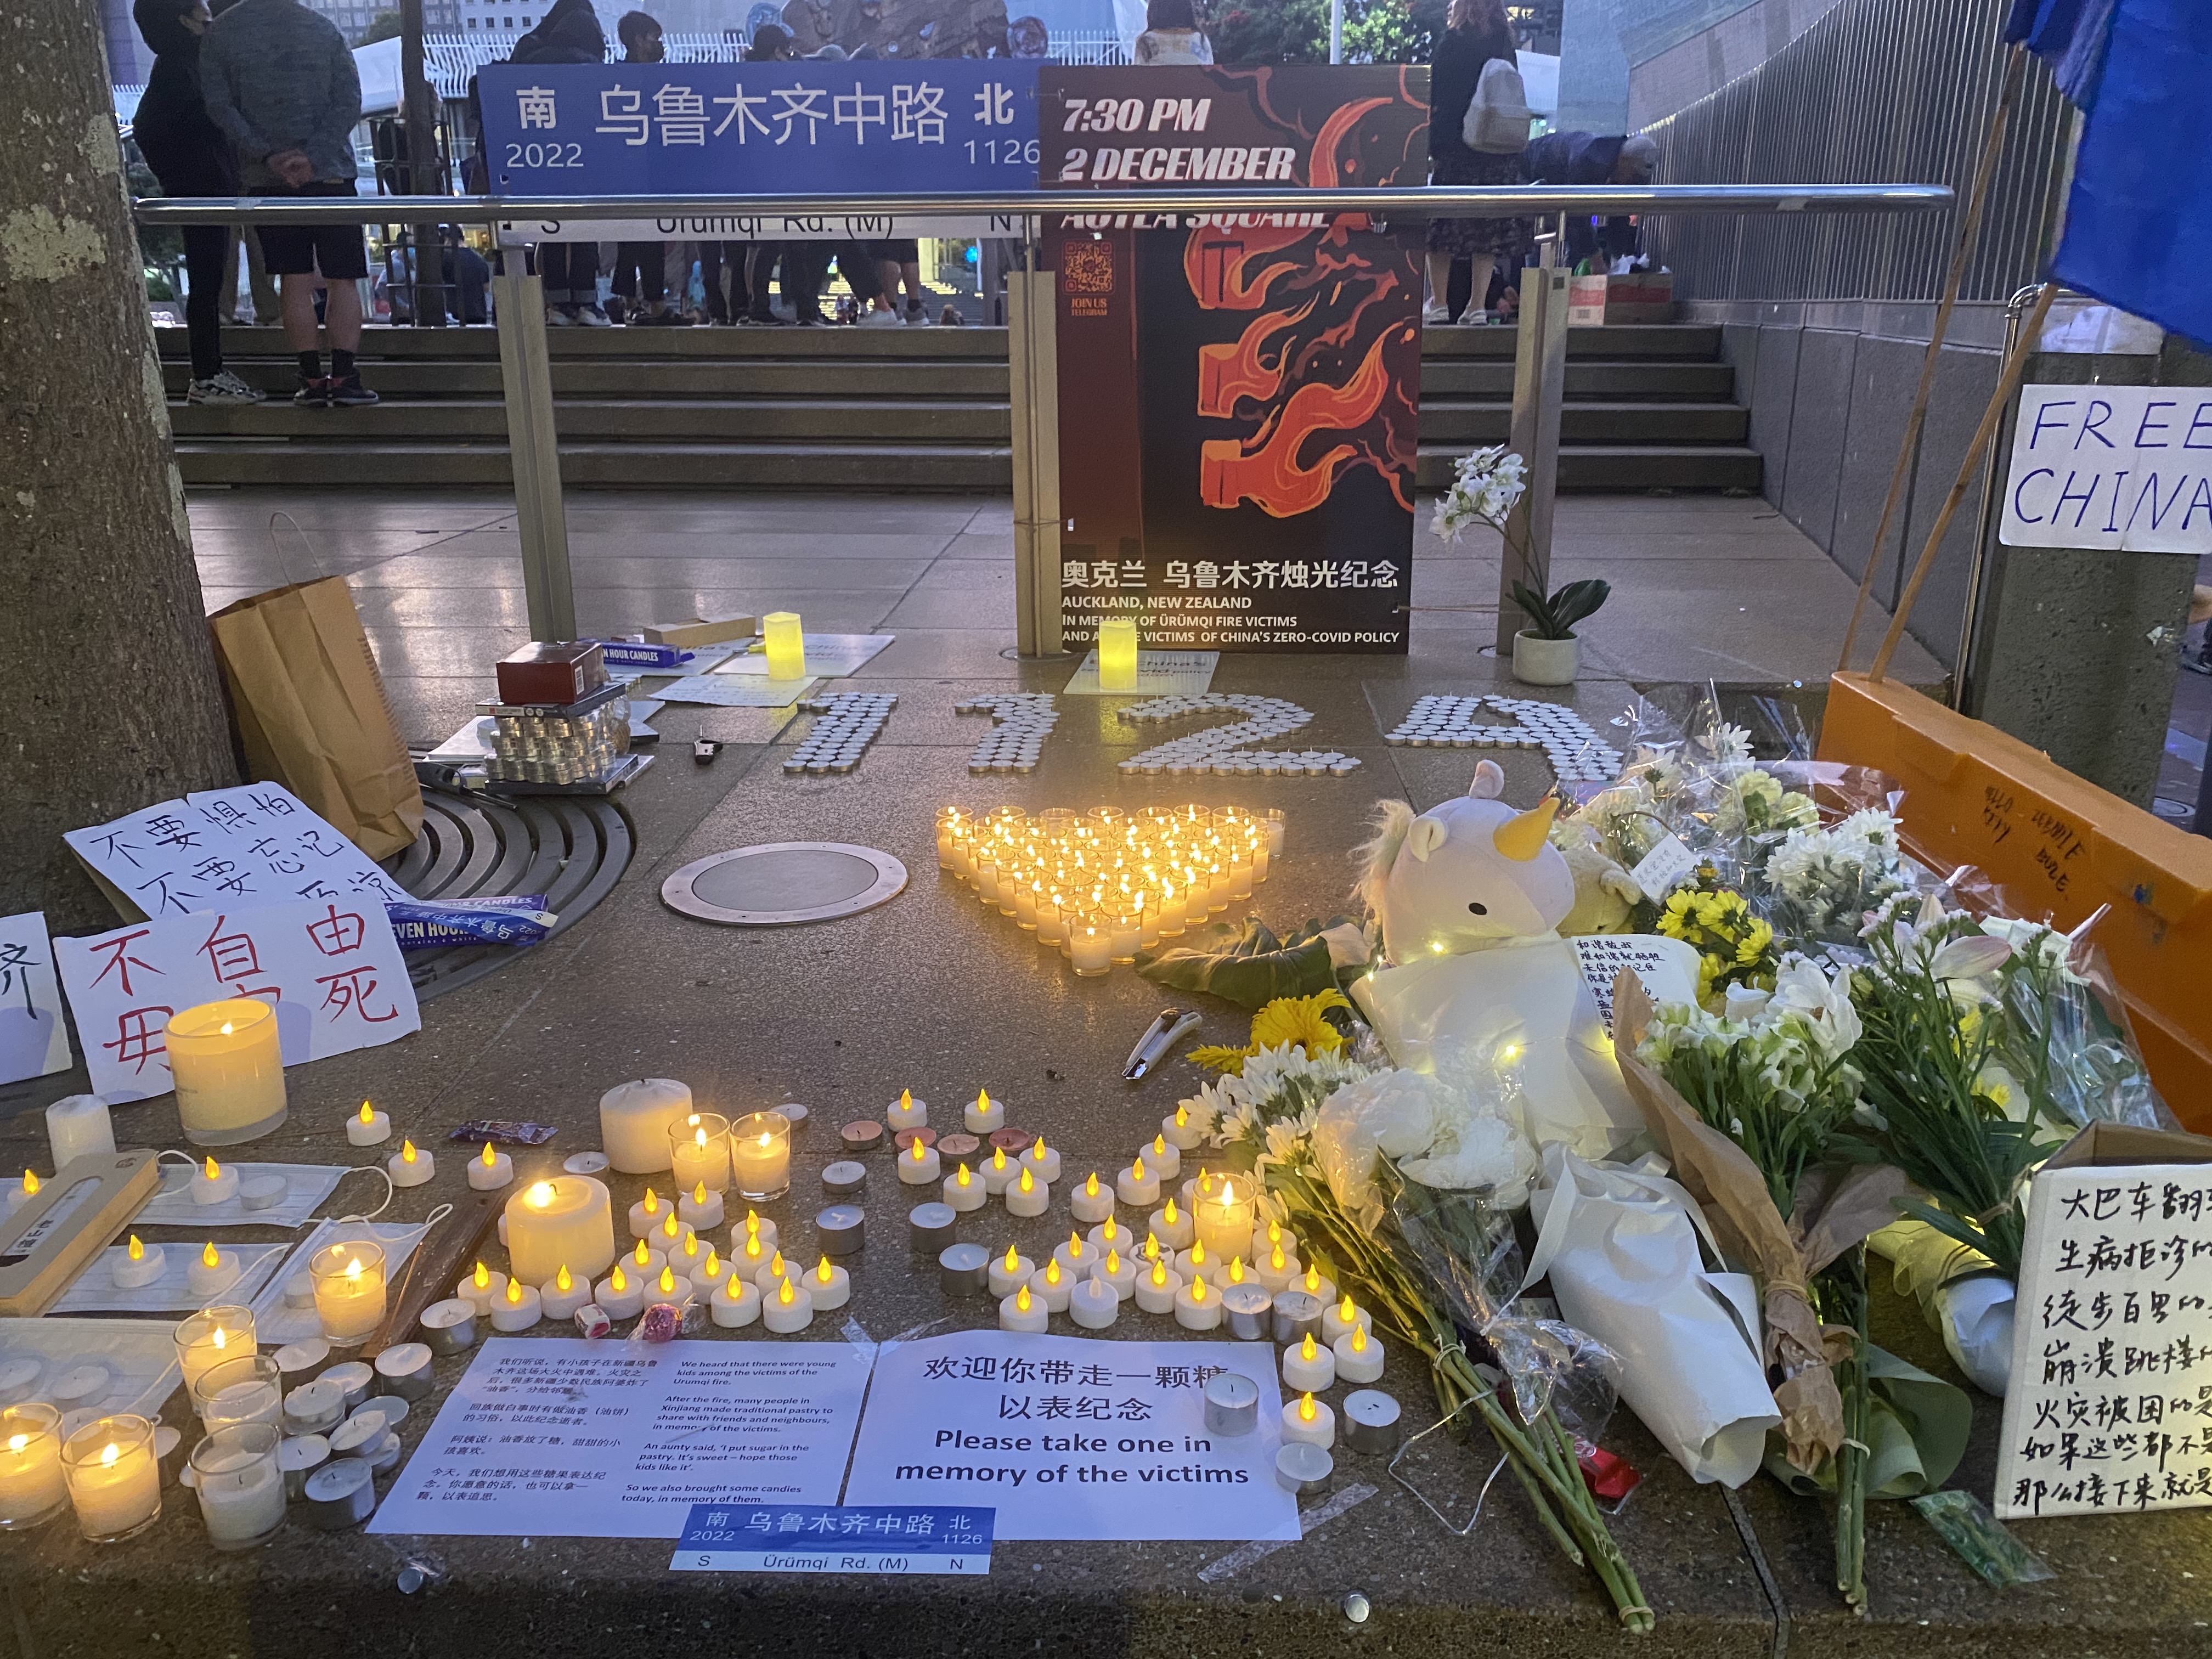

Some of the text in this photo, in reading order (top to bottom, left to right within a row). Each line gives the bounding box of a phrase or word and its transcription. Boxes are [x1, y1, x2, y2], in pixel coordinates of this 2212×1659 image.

[516, 82, 1013, 146] 南 乌鲁木齐中路 北
[1062, 99, 1211, 132] 7:30 PM
[506, 139, 1039, 167] 2022 1126
[1062, 147, 1295, 180] 2 DECEMBER
[2030, 401, 2212, 449] FREE
[2015, 468, 2212, 532] CHINA
[1062, 561, 1398, 589] 奥克兰 乌鲁木齐烛光纪念
[1062, 597, 1251, 610] AUCKLAND, NEW ZEALAND
[1062, 614, 1076, 626] IN
[1139, 616, 1156, 627] OF
[1216, 617, 1242, 626] FIRE
[1246, 617, 1296, 626] VICTIMS
[1062, 631, 1089, 641] AND
[1144, 632, 1194, 642] VICTIMS
[1201, 633, 1218, 642] OF
[1220, 631, 1271, 642] CHINA'S
[1273, 633, 1351, 642] ZERO-COVID
[1355, 633, 1399, 642] POLICY
[609, 649, 629, 659] HOUR
[629, 651, 658, 662] CANDLES
[90, 793, 296, 868] 不要惧怕
[137, 831, 345, 914] 不要忘记
[475, 898, 533, 906] CANDLES
[416, 911, 514, 939] 乌鲁木齐中路
[90, 905, 365, 996] 不自由
[103, 966, 398, 1075] 毋死
[2043, 1290, 2212, 1331] 徒步百里的
[1000, 1395, 1152, 1420] 以表纪念
[709, 1424, 721, 1432] of
[936, 1430, 1210, 1452] Please take one in
[896, 1465, 1248, 1486] memory of the victims
[622, 1495, 654, 1503] today,
[684, 1485, 727, 1493] brought
[706, 1512, 971, 1535] 南 乌鲁木齐中路 北
[689, 1531, 983, 1544] 2022 1126
[698, 1555, 962, 1571] S Ürümqi Rd. (M) N
